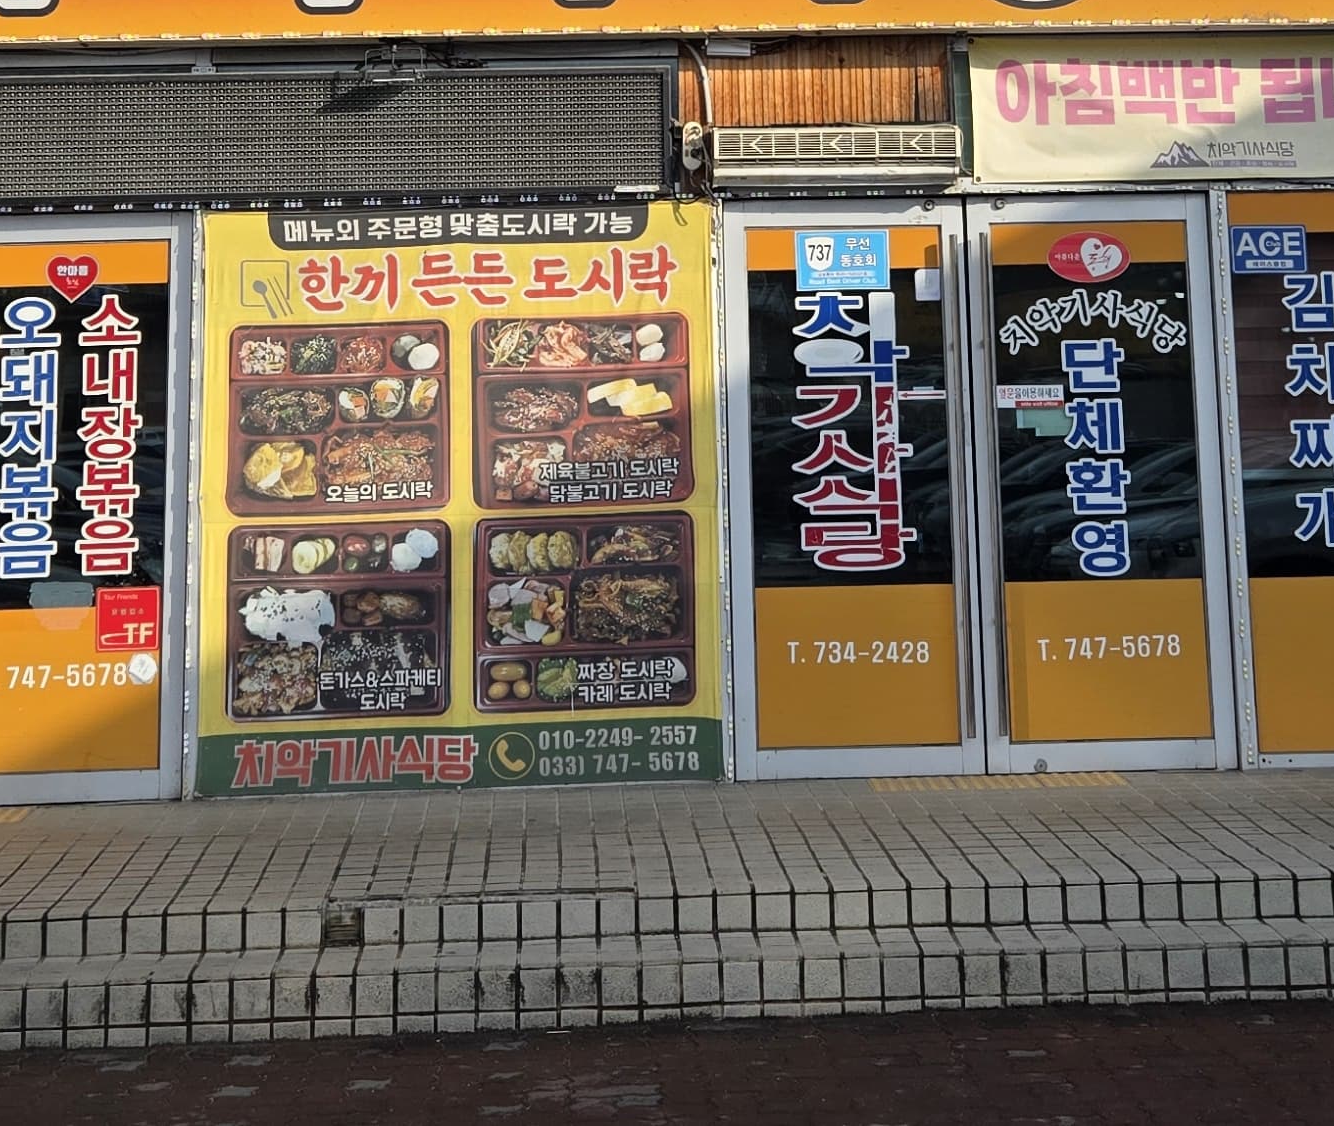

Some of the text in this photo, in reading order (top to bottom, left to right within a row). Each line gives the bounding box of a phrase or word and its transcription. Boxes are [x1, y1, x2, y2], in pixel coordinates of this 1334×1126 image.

[995, 57, 1240, 125] 아침백반
[1207, 141, 1295, 158] 치악기사식당
[283, 211, 633, 243] 메뉴외 주문형 맞춤도시락 가능
[807, 243, 832, 262] 737
[845, 237, 870, 251] 무선
[1236, 231, 1302, 257] ACE
[840, 253, 877, 267] 동호회
[298, 244, 679, 312] 한끼 든든 도시락
[999, 288, 1187, 356] 치악기사식당
[75, 293, 143, 577] 소내장볶음
[1060, 337, 1131, 577] 단체환영
[540, 459, 679, 481] 제육불고기 도시락
[325, 482, 433, 503] 오늘의 도시락
[549, 481, 673, 503] 닭불고기 도시락
[123, 622, 155, 645] TF
[787, 640, 930, 664] T. 734-2428
[1037, 634, 1182, 661] T. 747-5678
[6, 662, 127, 689] 747-5678
[318, 668, 442, 691] 돈가스&스파케티
[577, 659, 674, 681] 짜장 도시락
[359, 692, 407, 711] 도시락
[578, 682, 673, 704] 카레 도시락
[231, 732, 479, 790] 치악기사식당
[648, 750, 700, 772] 5678
